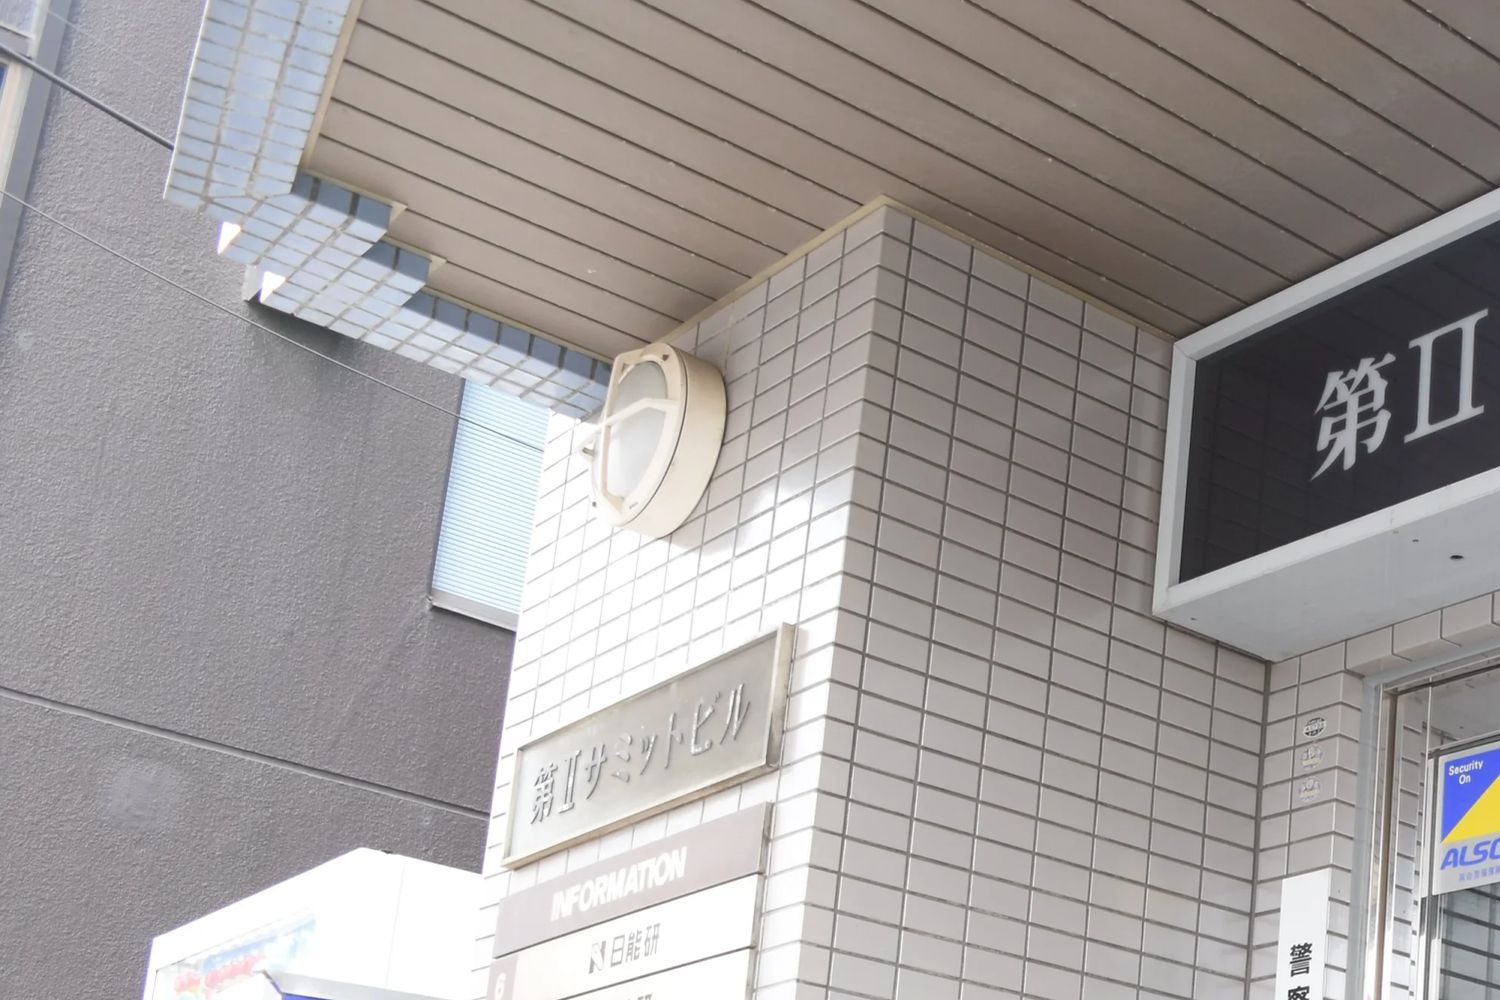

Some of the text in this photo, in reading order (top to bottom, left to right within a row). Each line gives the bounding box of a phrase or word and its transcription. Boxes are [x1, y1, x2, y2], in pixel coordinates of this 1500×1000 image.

[1449, 760, 1484, 776] Security
[1459, 774, 1471, 784] On
[551, 847, 687, 921] INFORMATION
[610, 923, 661, 968] 日能研
